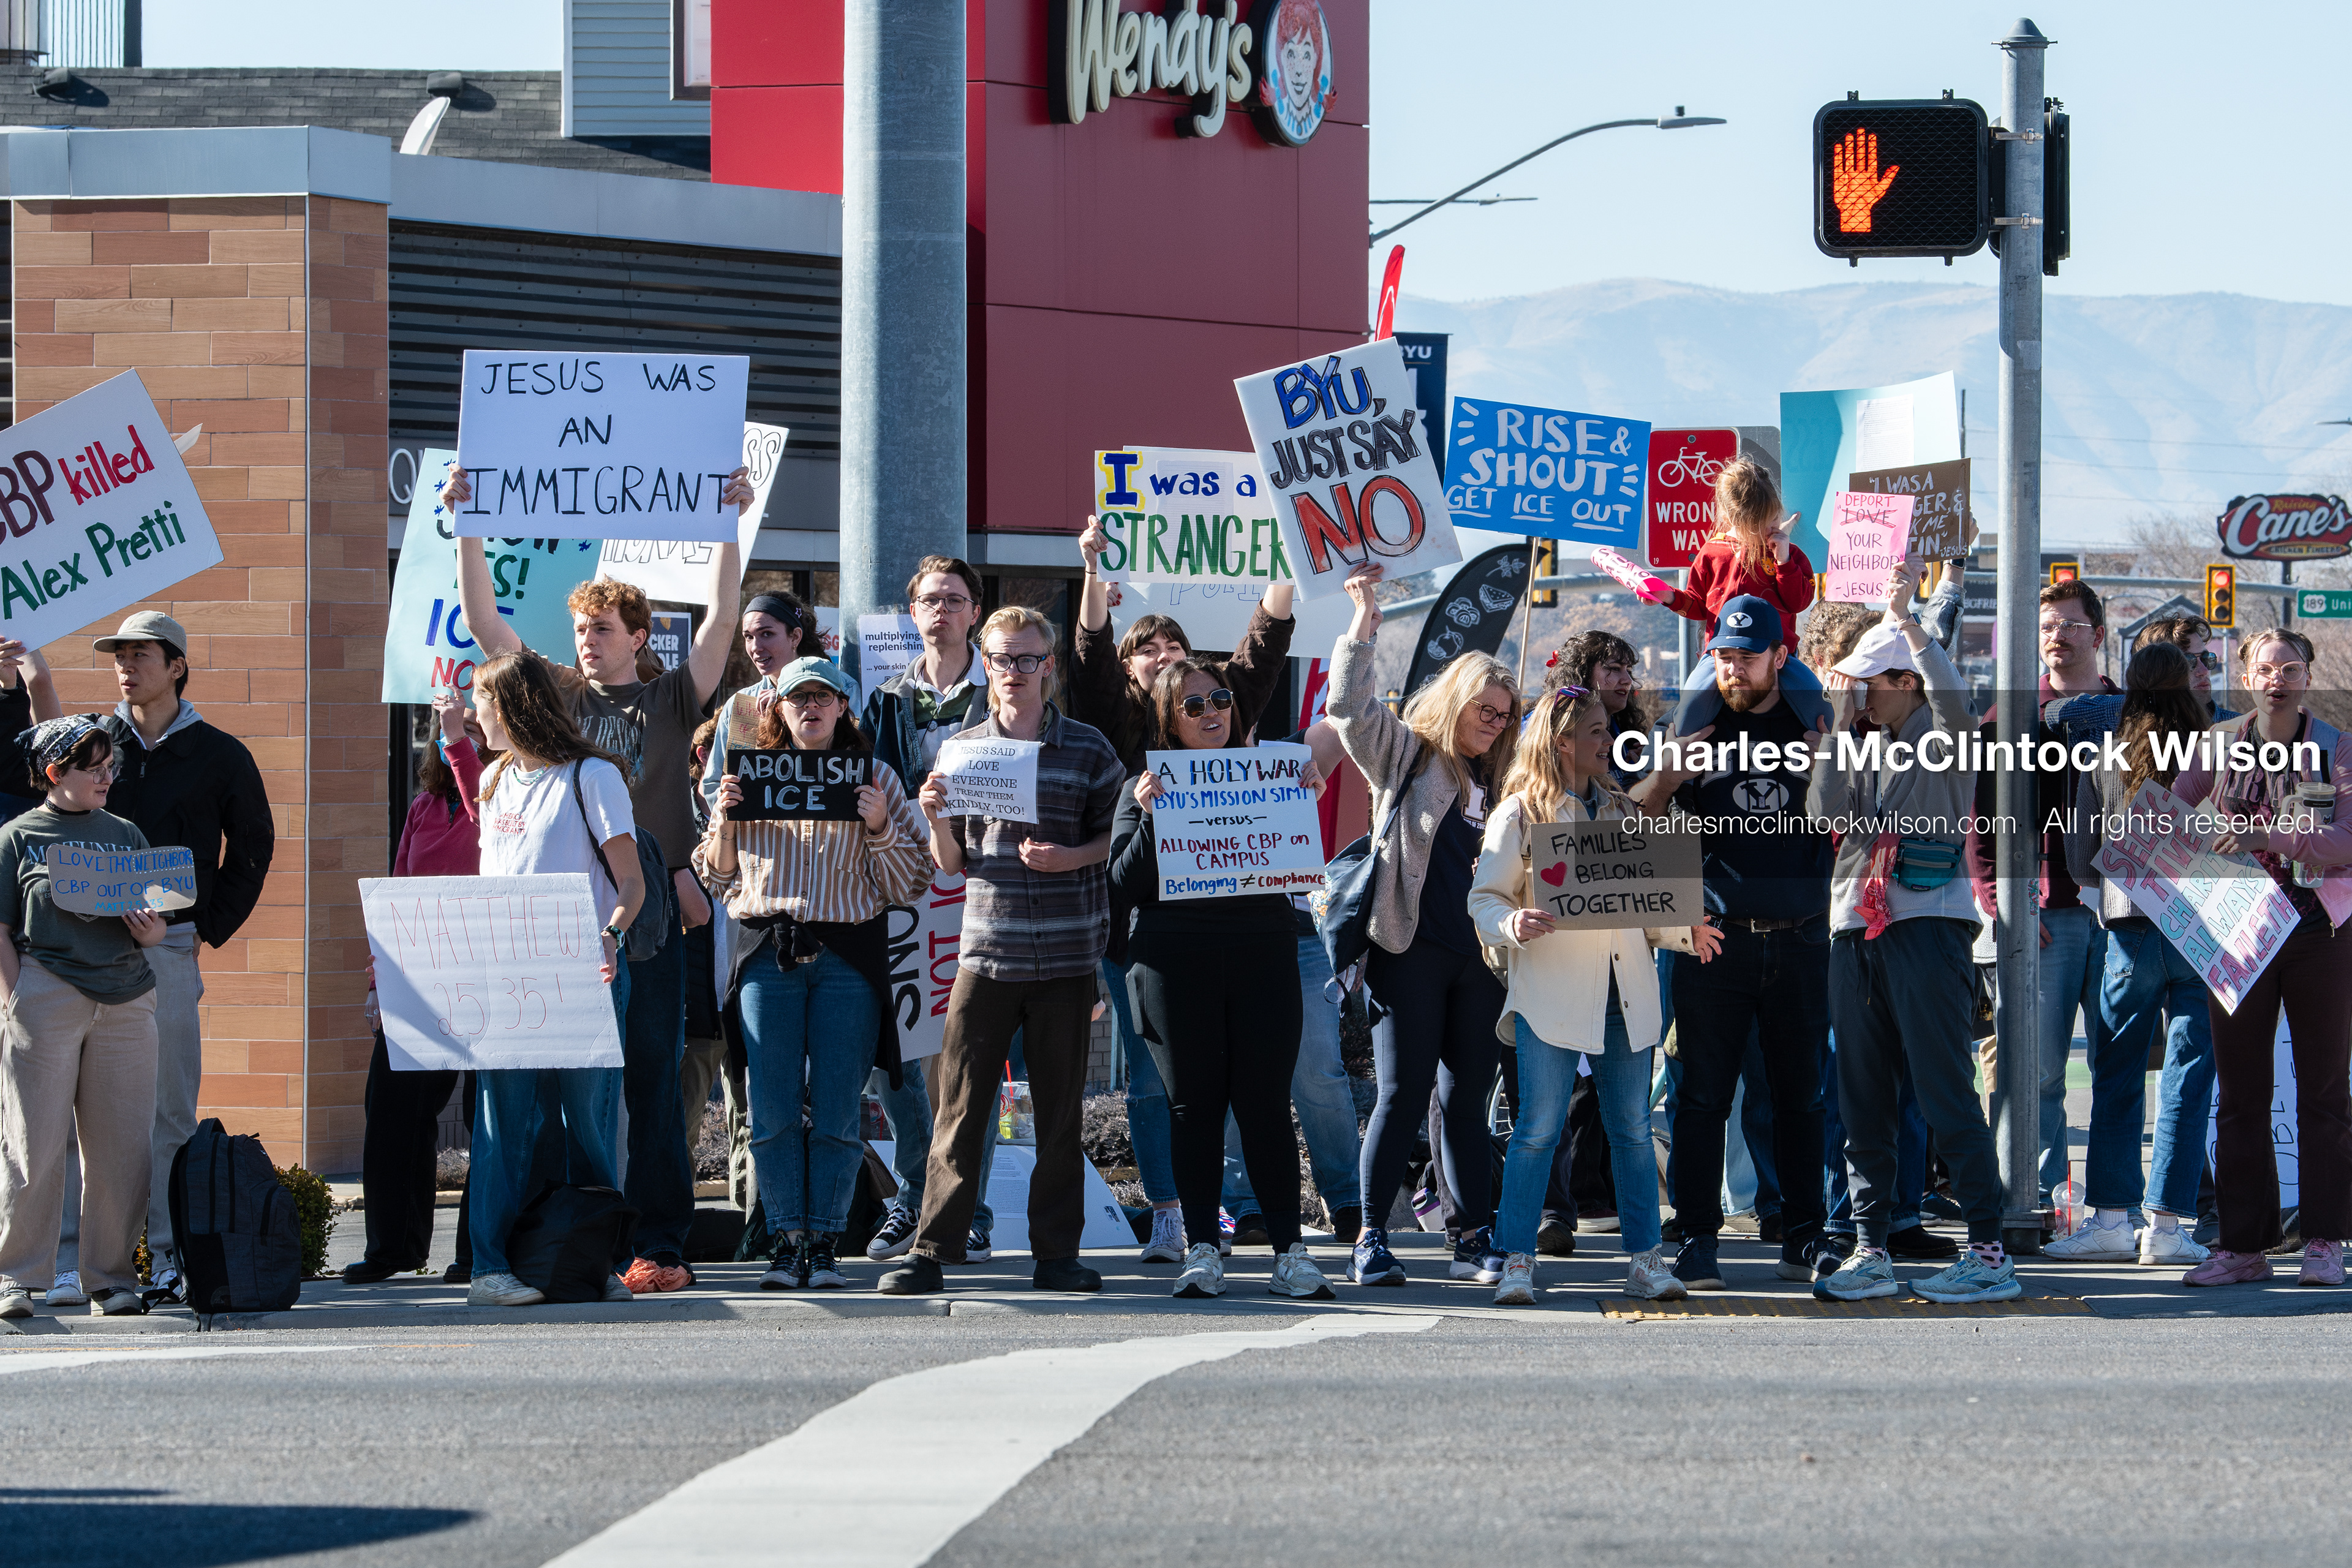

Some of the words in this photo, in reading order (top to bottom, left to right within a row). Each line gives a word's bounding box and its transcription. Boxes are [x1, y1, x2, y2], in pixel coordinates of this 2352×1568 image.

[1066, 0, 1252, 138] Wendy's
[481, 358, 604, 394] JESUS
[643, 363, 717, 392] WAS
[1273, 355, 1387, 429] BYU,
[558, 414, 612, 447] AN
[1497, 408, 1608, 456] RISE
[1609, 426, 1632, 456] &
[1270, 427, 1352, 489] JUST
[1352, 409, 1421, 472] SAY
[58, 424, 155, 505] killed
[1460, 448, 1619, 496] SHOUT
[462, 466, 731, 515] IMMIGRANT
[1102, 452, 1139, 507] I
[1150, 469, 1220, 498] was
[1236, 473, 1257, 498] a
[1887, 475, 1920, 494] WAS
[1922, 470, 1934, 491] A
[1446, 485, 1498, 511] GET
[1513, 492, 1555, 515] ICE
[1572, 498, 1631, 526] OUT
[1656, 502, 1715, 523] WRON
[1845, 493, 1896, 508] DEPORT
[1291, 475, 1426, 575] NO
[2226, 495, 2348, 555] Cane's
[1101, 512, 1294, 581] STRANGER
[1672, 530, 1713, 551] WAY
[1846, 531, 1883, 550] YOUR
[1, 552, 88, 619] Alex
[85, 500, 186, 577] Pretti
[2305, 598, 2324, 609] 189
[424, 598, 514, 649] IC
[959, 746, 989, 755] JESUS
[990, 747, 1016, 756] SAID
[738, 754, 864, 783] ABOLISH
[968, 760, 1000, 771] LOVE
[1158, 761, 1177, 785] A
[1190, 758, 1252, 786] HOLY
[1256, 758, 1302, 782] WAR
[952, 775, 1017, 788] EVERYONE
[955, 788, 984, 798] TREAT
[986, 791, 1014, 801] THEM
[765, 786, 826, 810] ICE
[948, 799, 995, 813] KINDLY,
[996, 804, 1025, 815] TOO!
[1200, 788, 1266, 810] MISSION
[1160, 837, 1241, 853] ALLOWING
[1247, 833, 1283, 850] CBP
[1291, 834, 1310, 845] on
[1551, 831, 1648, 856] FAMILIES
[58, 850, 104, 872] LOVE
[107, 855, 132, 873] THY
[135, 849, 194, 872] NEIGHBOR
[1196, 851, 1270, 870] CAMPUS
[1576, 861, 1654, 884] BELONG
[55, 878, 91, 894] CBP
[97, 882, 127, 897] OUT
[130, 880, 154, 895] OF
[162, 875, 194, 893] BYU
[95, 901, 126, 911] MATT
[1549, 891, 1676, 918] TOGETHER
[2183, 859, 2266, 972] ALWAYS
[390, 893, 581, 974] MATTHEW
[2207, 884, 2296, 1010] FAILETH
